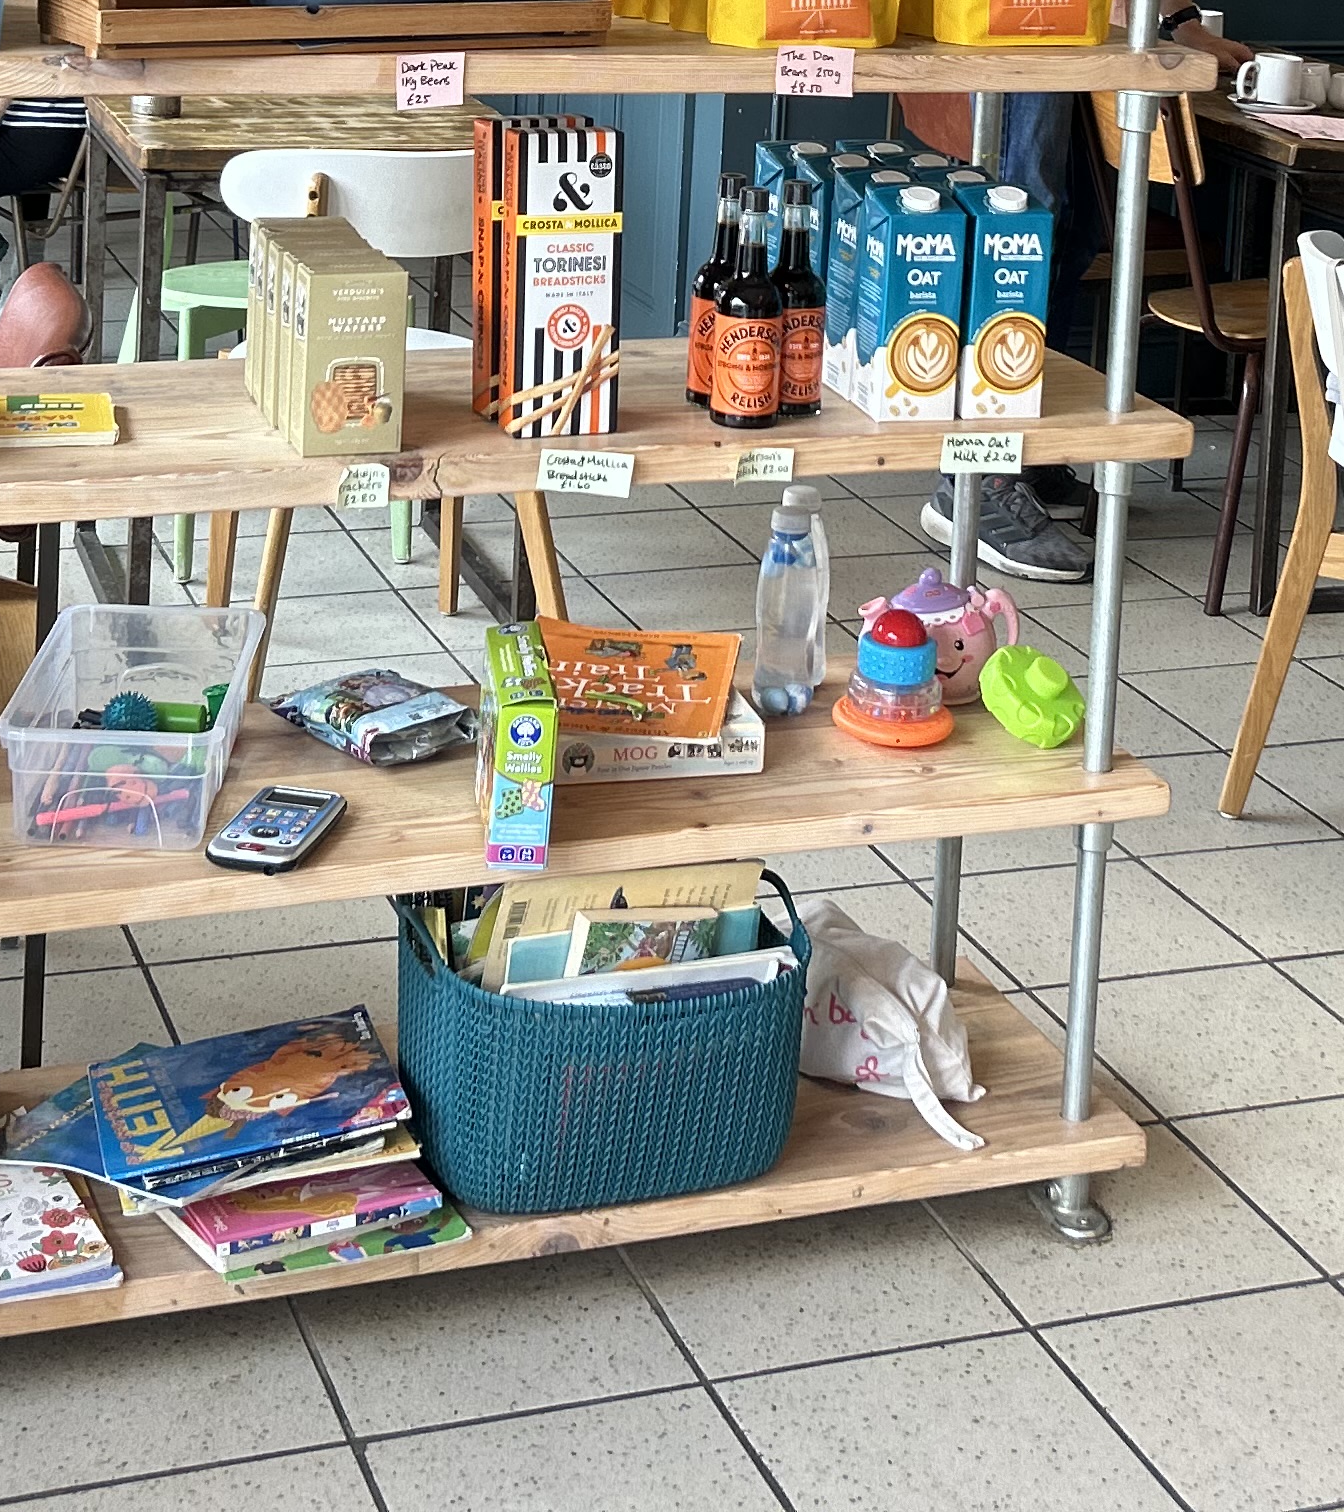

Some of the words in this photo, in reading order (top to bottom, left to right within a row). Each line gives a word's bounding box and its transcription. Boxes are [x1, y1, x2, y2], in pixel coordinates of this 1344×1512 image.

[781, 50, 808, 62] The
[812, 50, 835, 62] Don
[401, 60, 429, 74] Dark
[429, 58, 459, 73] Peak
[420, 75, 451, 87] Beans
[780, 65, 808, 78] Beans
[815, 66, 842, 85] 250g
[406, 92, 432, 106] £25
[522, 219, 564, 231] CROSTA
[574, 217, 618, 229] MOLLICA
[546, 242, 595, 254] CLASSIC
[895, 232, 957, 262] MOMA
[983, 232, 1044, 261] MOMA
[533, 255, 607, 274] TORINESI
[532, 273, 607, 287] BREADSTICKS
[906, 267, 943, 287] OAT
[993, 267, 1030, 286] OAT
[909, 290, 937, 300] barista
[996, 289, 1025, 299] barista
[327, 316, 387, 326] MUSTARD
[332, 324, 383, 334] WAFERS
[730, 392, 773, 409] RELISH
[983, 449, 1017, 463] £2.00
[505, 750, 543, 766] Smelly
[613, 745, 659, 763] MOG
[504, 762, 543, 775] Wellies
[105, 1058, 186, 1162] KEITH
